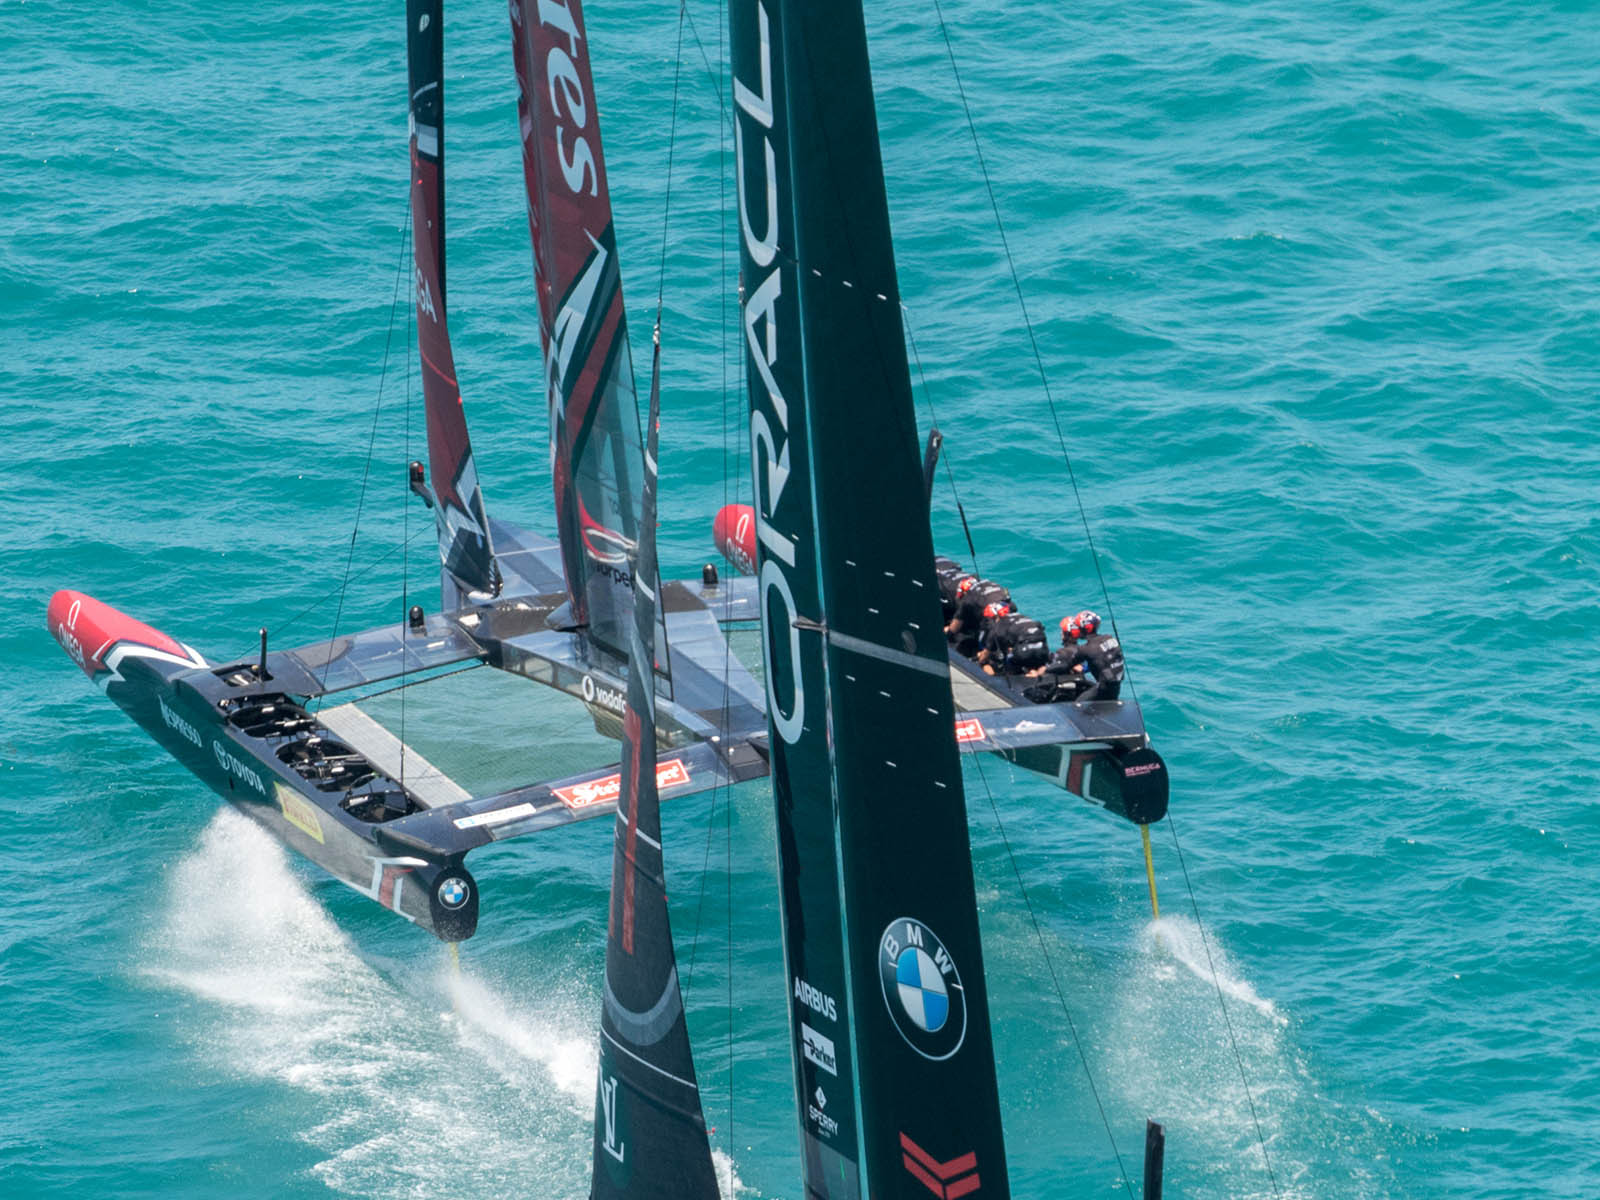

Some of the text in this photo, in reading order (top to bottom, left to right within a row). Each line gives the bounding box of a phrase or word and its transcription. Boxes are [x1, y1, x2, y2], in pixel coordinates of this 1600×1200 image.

[227, 751, 266, 796] TOYOTA
[795, 976, 837, 1022] AIRBUS
[806, 1037, 836, 1069] Parker
[809, 1104, 839, 1136] SPERRY
